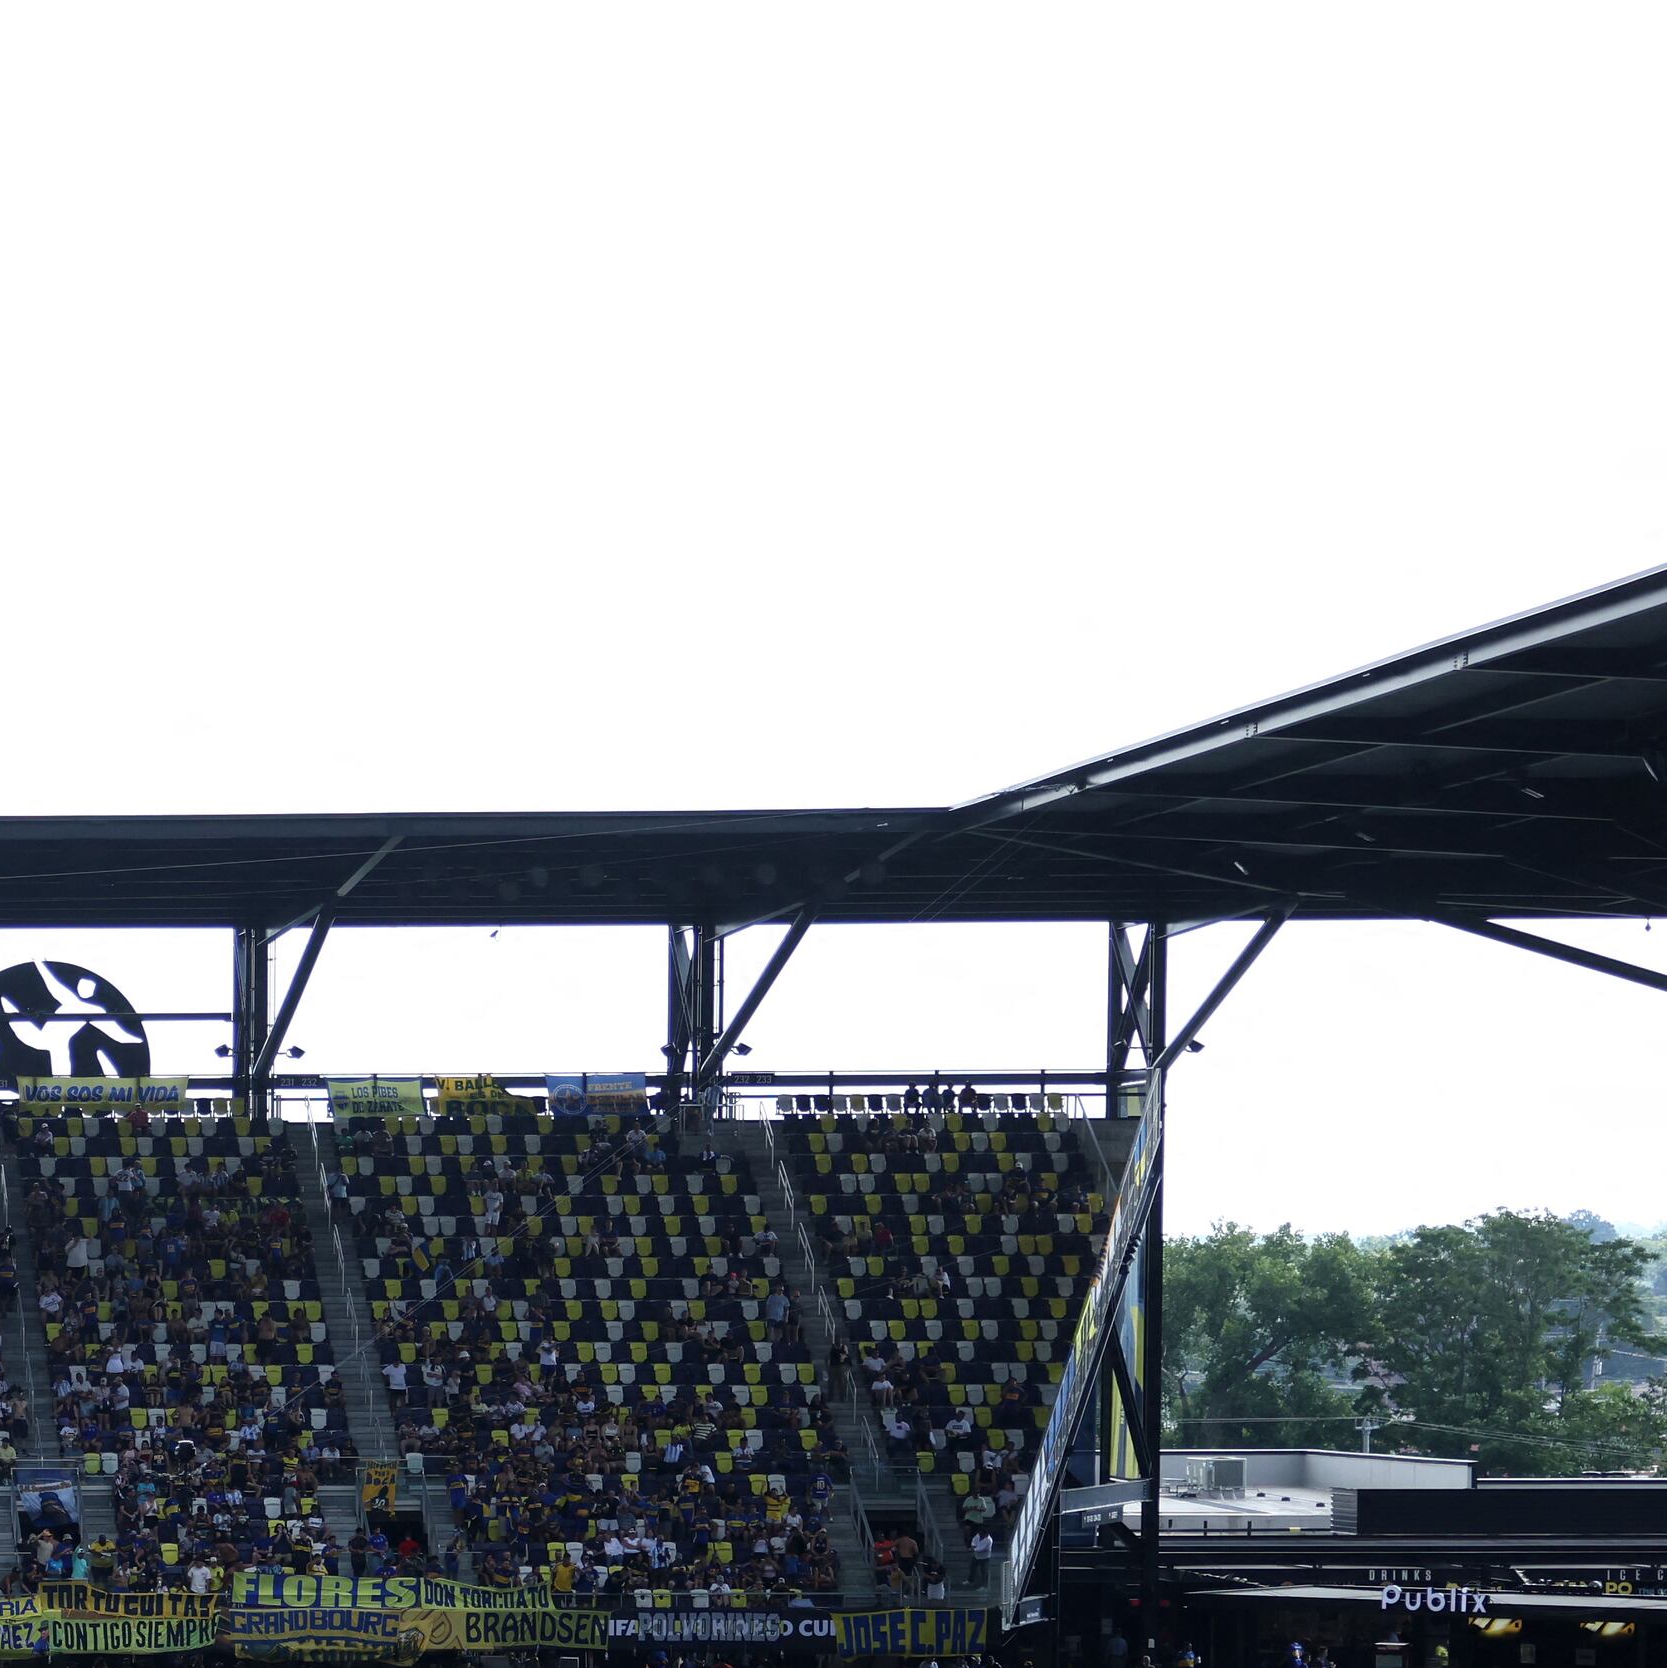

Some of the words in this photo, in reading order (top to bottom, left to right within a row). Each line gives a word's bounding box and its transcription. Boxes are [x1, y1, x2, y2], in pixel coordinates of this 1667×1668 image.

[25, 1085, 62, 1103] VOS
[68, 1085, 103, 1103] SOS
[108, 1085, 132, 1103] MI
[137, 1085, 180, 1103] VIDA
[351, 1087, 368, 1099] LOS
[372, 1087, 398, 1099] PIBES
[1369, 1570, 1432, 1581] DRINKS
[1607, 1569, 1641, 1581] ICE
[241, 1574, 416, 1608] FLORES
[425, 1582, 455, 1607] DON
[461, 1585, 549, 1608] TORCUATO
[1381, 1585, 1488, 1613] Publix
[53, 1620, 131, 1651] CONTIGO
[136, 1617, 219, 1649] SIEMPRE
[468, 1612, 608, 1645] BRANDSEN
[637, 1611, 779, 1642] POLVORINES
[840, 1611, 906, 1651] JOSE
[940, 1609, 986, 1650] PAZ
